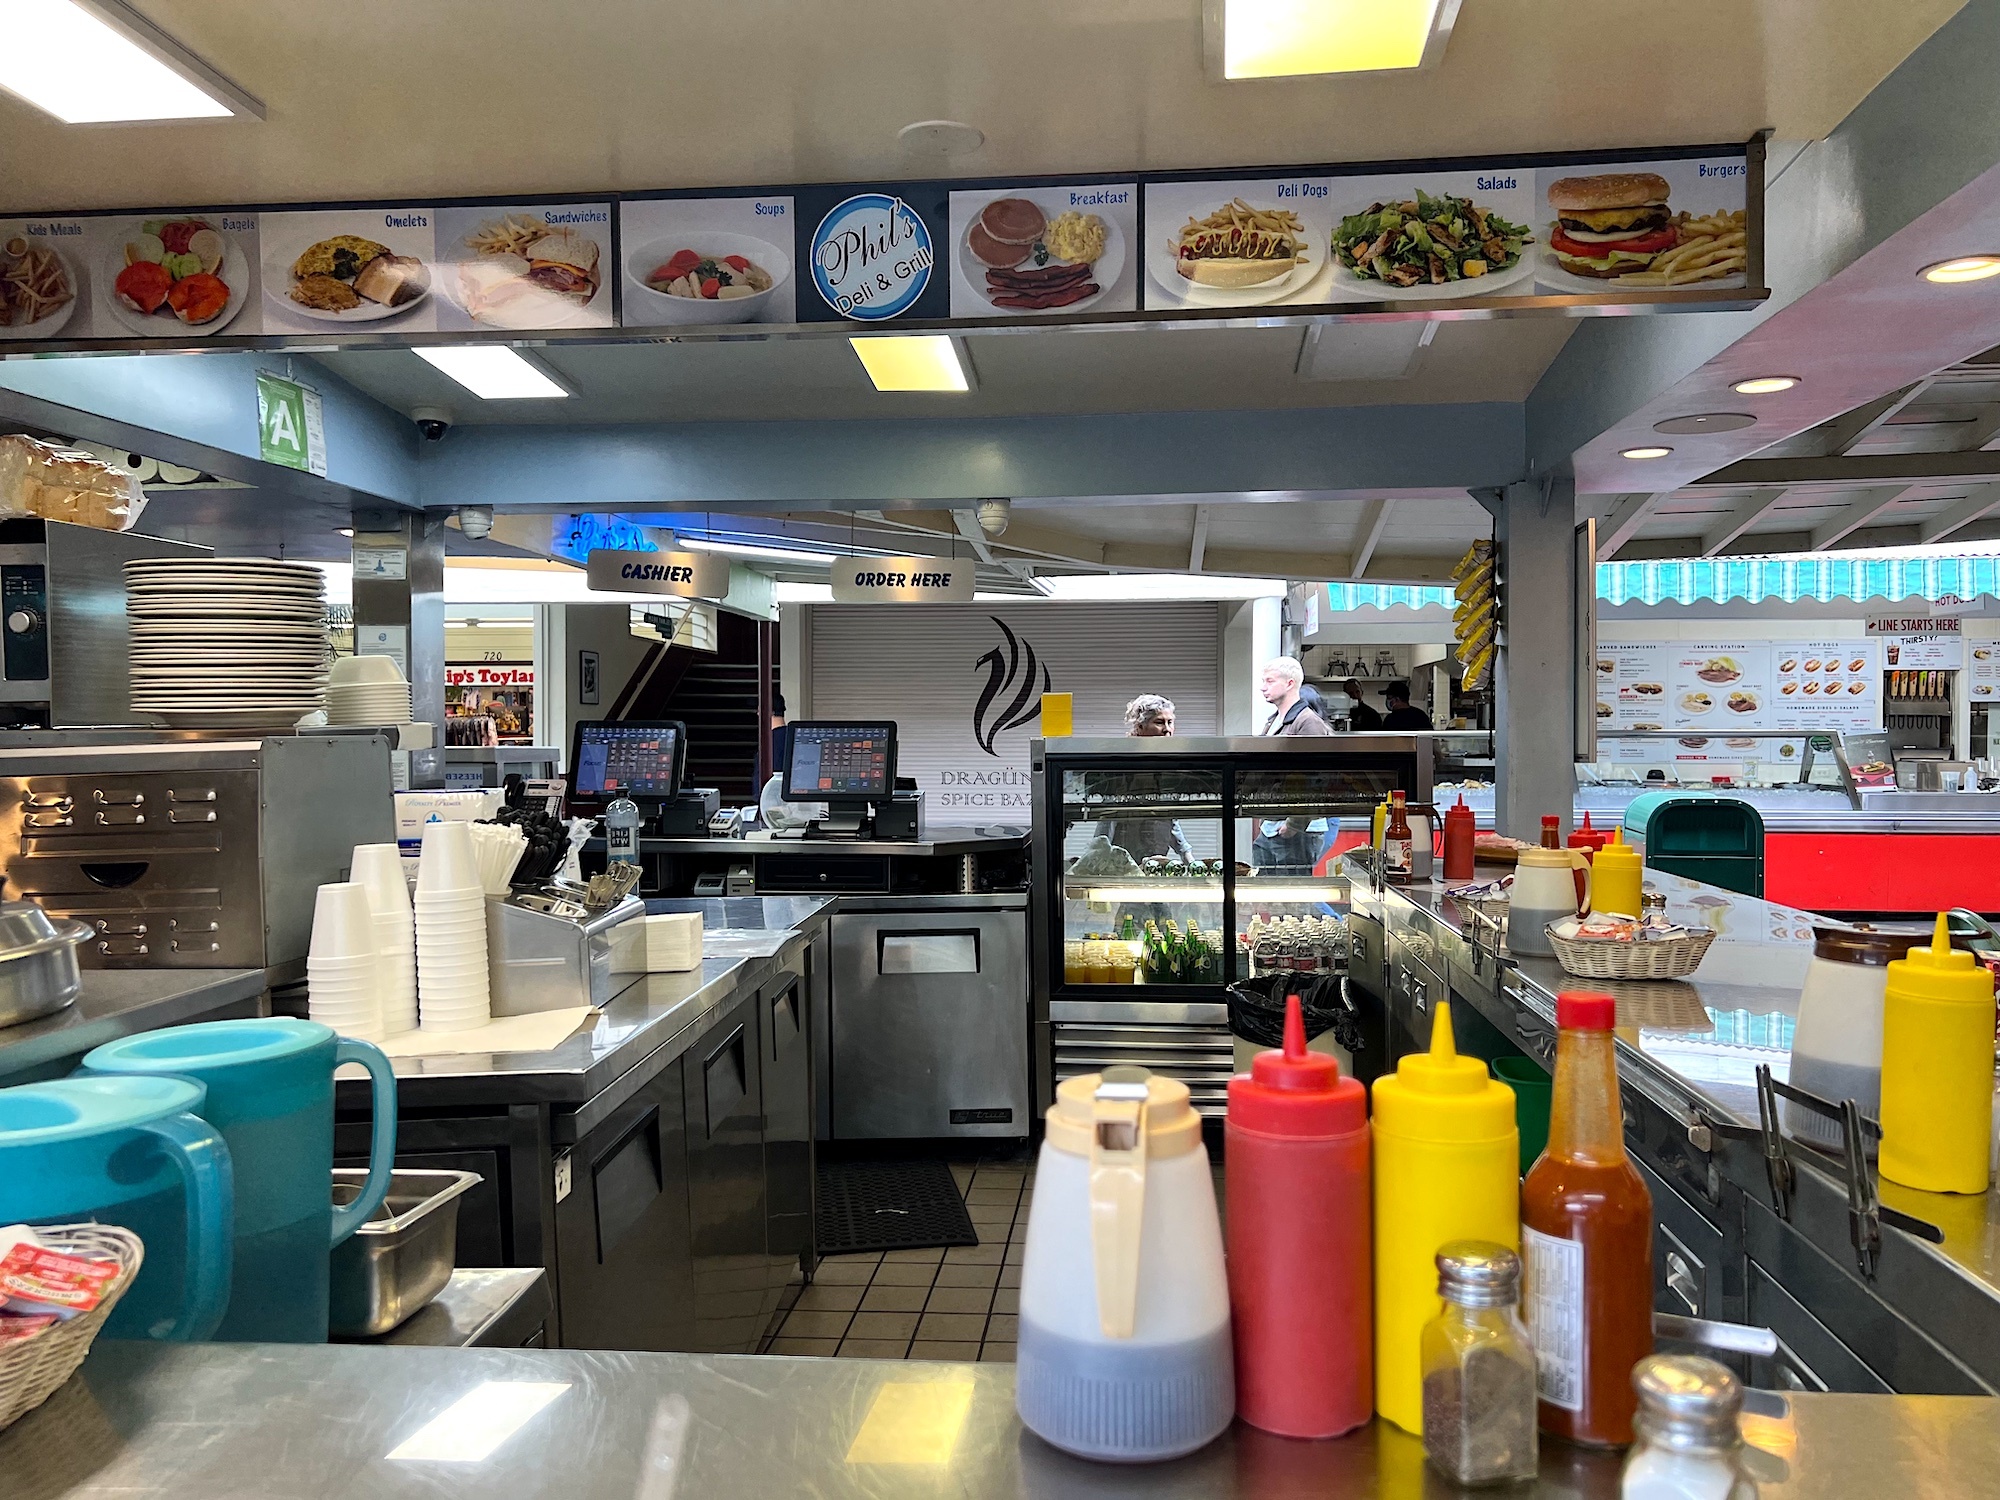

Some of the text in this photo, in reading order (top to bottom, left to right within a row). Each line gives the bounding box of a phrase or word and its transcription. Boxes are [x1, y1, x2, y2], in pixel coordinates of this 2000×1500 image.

[1698, 163, 1746, 179] Burgers
[1277, 183, 1328, 199] Deli Dogs
[1476, 176, 1517, 191] Salads
[1069, 191, 1128, 206] Breakfast
[754, 201, 785, 217] Soups
[222, 217, 255, 231] Bagels
[385, 214, 427, 227] Omelets
[545, 210, 607, 224] Sandwiches
[26, 223, 82, 236] Kids Meals
[817, 197, 917, 286] Phil's
[835, 247, 933, 315] Deli & Grill
[270, 399, 301, 452] A
[621, 563, 694, 584] CASHIER
[855, 572, 952, 588] ORDER HERE
[1878, 618, 1959, 631] LINE STARTS HERE
[483, 651, 503, 661] 720
[941, 766, 1032, 785] DRAGÜN
[941, 793, 995, 806] SPICE
